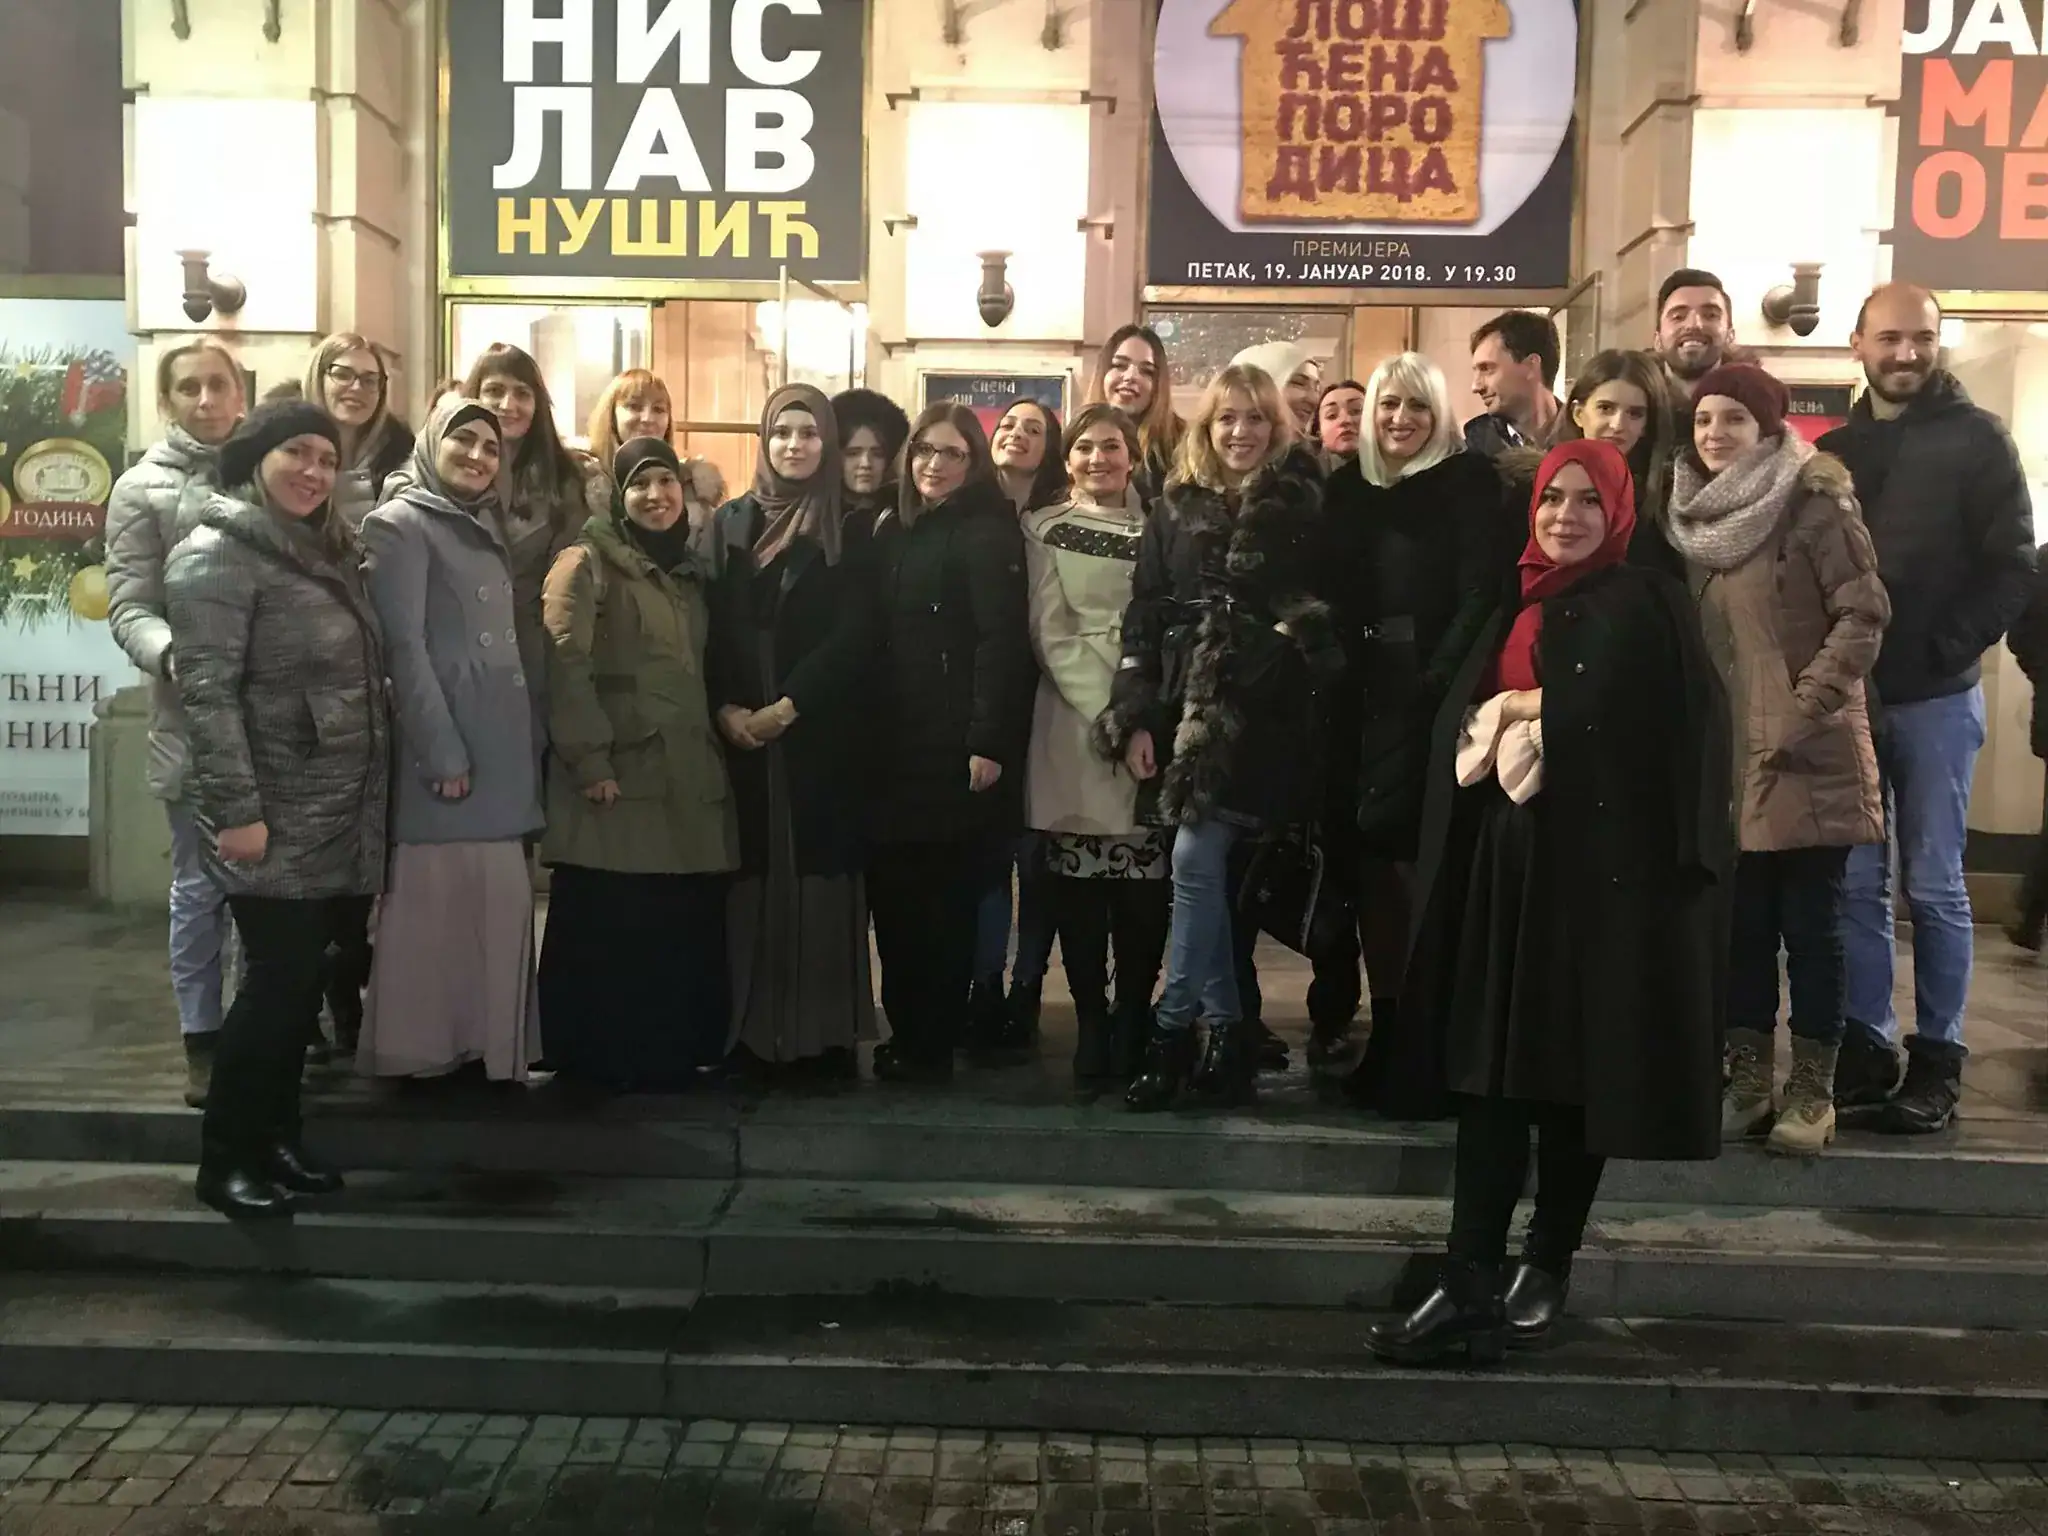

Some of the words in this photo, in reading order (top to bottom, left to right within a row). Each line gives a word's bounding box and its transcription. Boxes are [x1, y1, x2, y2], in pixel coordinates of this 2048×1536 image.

[503, 0, 823, 86] НИС
[1286, 0, 1449, 41] ЛОШ
[1902, 0, 2048, 56] ЈА
[1275, 40, 1460, 92] ЋЕНА
[1276, 92, 1454, 143] ПОРО
[1918, 58, 2048, 148] М
[493, 86, 816, 193] ЛАВ
[1266, 144, 1458, 203] ДИЦА
[497, 197, 819, 259] НУШИЋ
[1292, 240, 1411, 258] ПРЕМИЈЕРА
[1187, 262, 1256, 281] ПЕТАК,
[1264, 263, 1292, 280] 19.
[1299, 263, 1374, 281] ЈАНУАР
[1380, 264, 1432, 281] 2018.
[1444, 265, 1457, 282] У
[1464, 265, 1516, 282] 19.30
[14, 509, 95, 528] ГОДИНА
